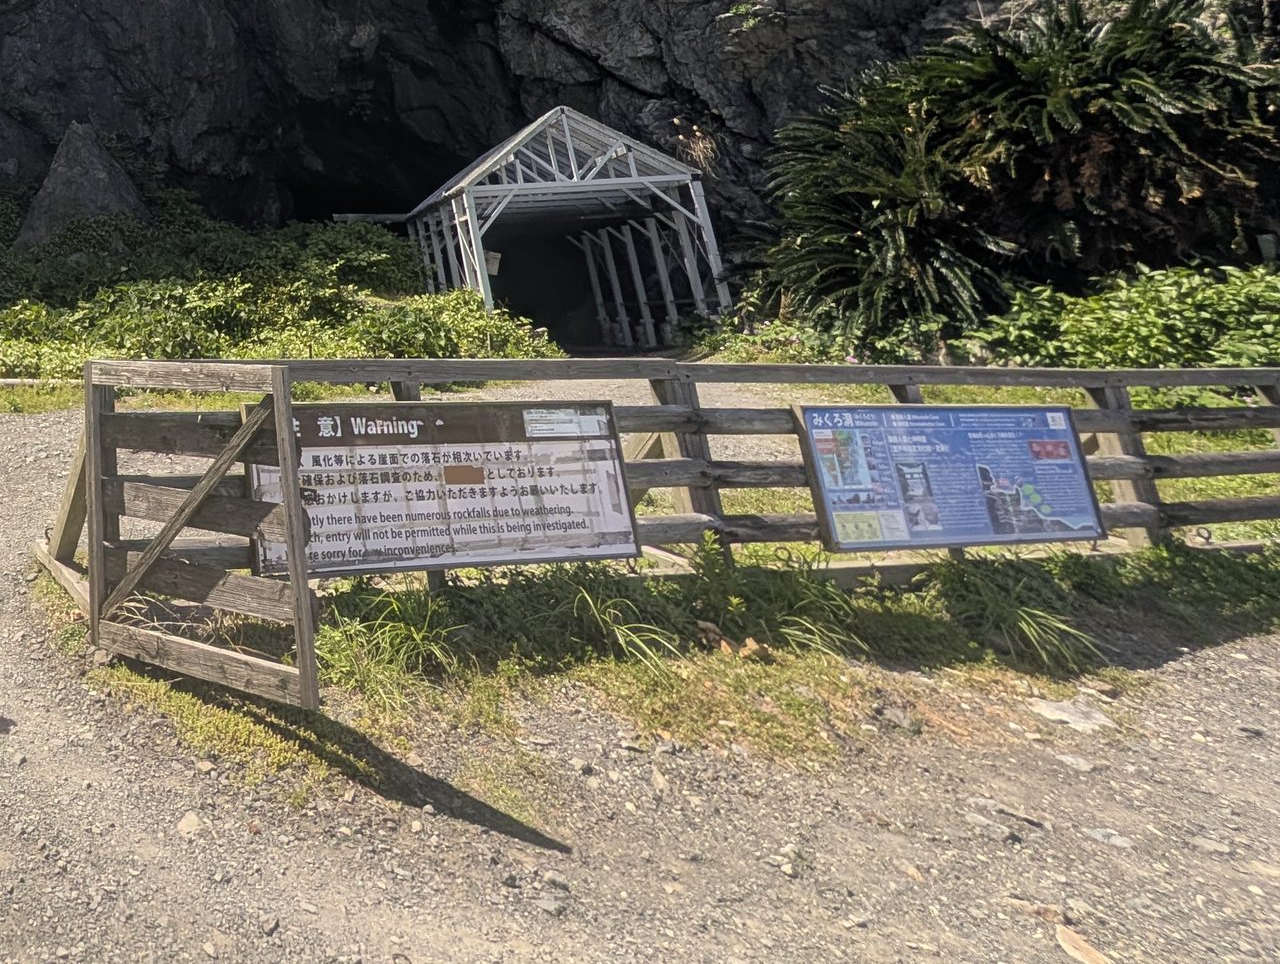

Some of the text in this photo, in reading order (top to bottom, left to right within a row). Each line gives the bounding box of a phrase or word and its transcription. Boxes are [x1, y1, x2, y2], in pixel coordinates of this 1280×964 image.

[351, 416, 419, 438] Warning
[298, 471, 439, 487] 確保および落石調査のため、
[327, 513, 353, 525] there
[355, 513, 378, 524] have
[380, 511, 403, 523] been
[405, 509, 451, 522] numerous
[453, 506, 490, 519] rockfalls
[493, 506, 509, 517] due
[511, 506, 521, 517] to
[522, 504, 574, 517] weathering.
[325, 532, 351, 545] entry
[353, 529, 371, 541] will
[373, 529, 389, 540] not
[390, 527, 403, 539] be
[405, 524, 451, 541] permitted
[452, 523, 477, 536] while
[479, 522, 496, 534] this
[497, 522, 505, 534] is
[506, 521, 532, 534] being
[533, 518, 590, 533] investigated.
[321, 549, 346, 561] sorry
[348, 546, 363, 558] for
[384, 542, 458, 557] inconveniences.
